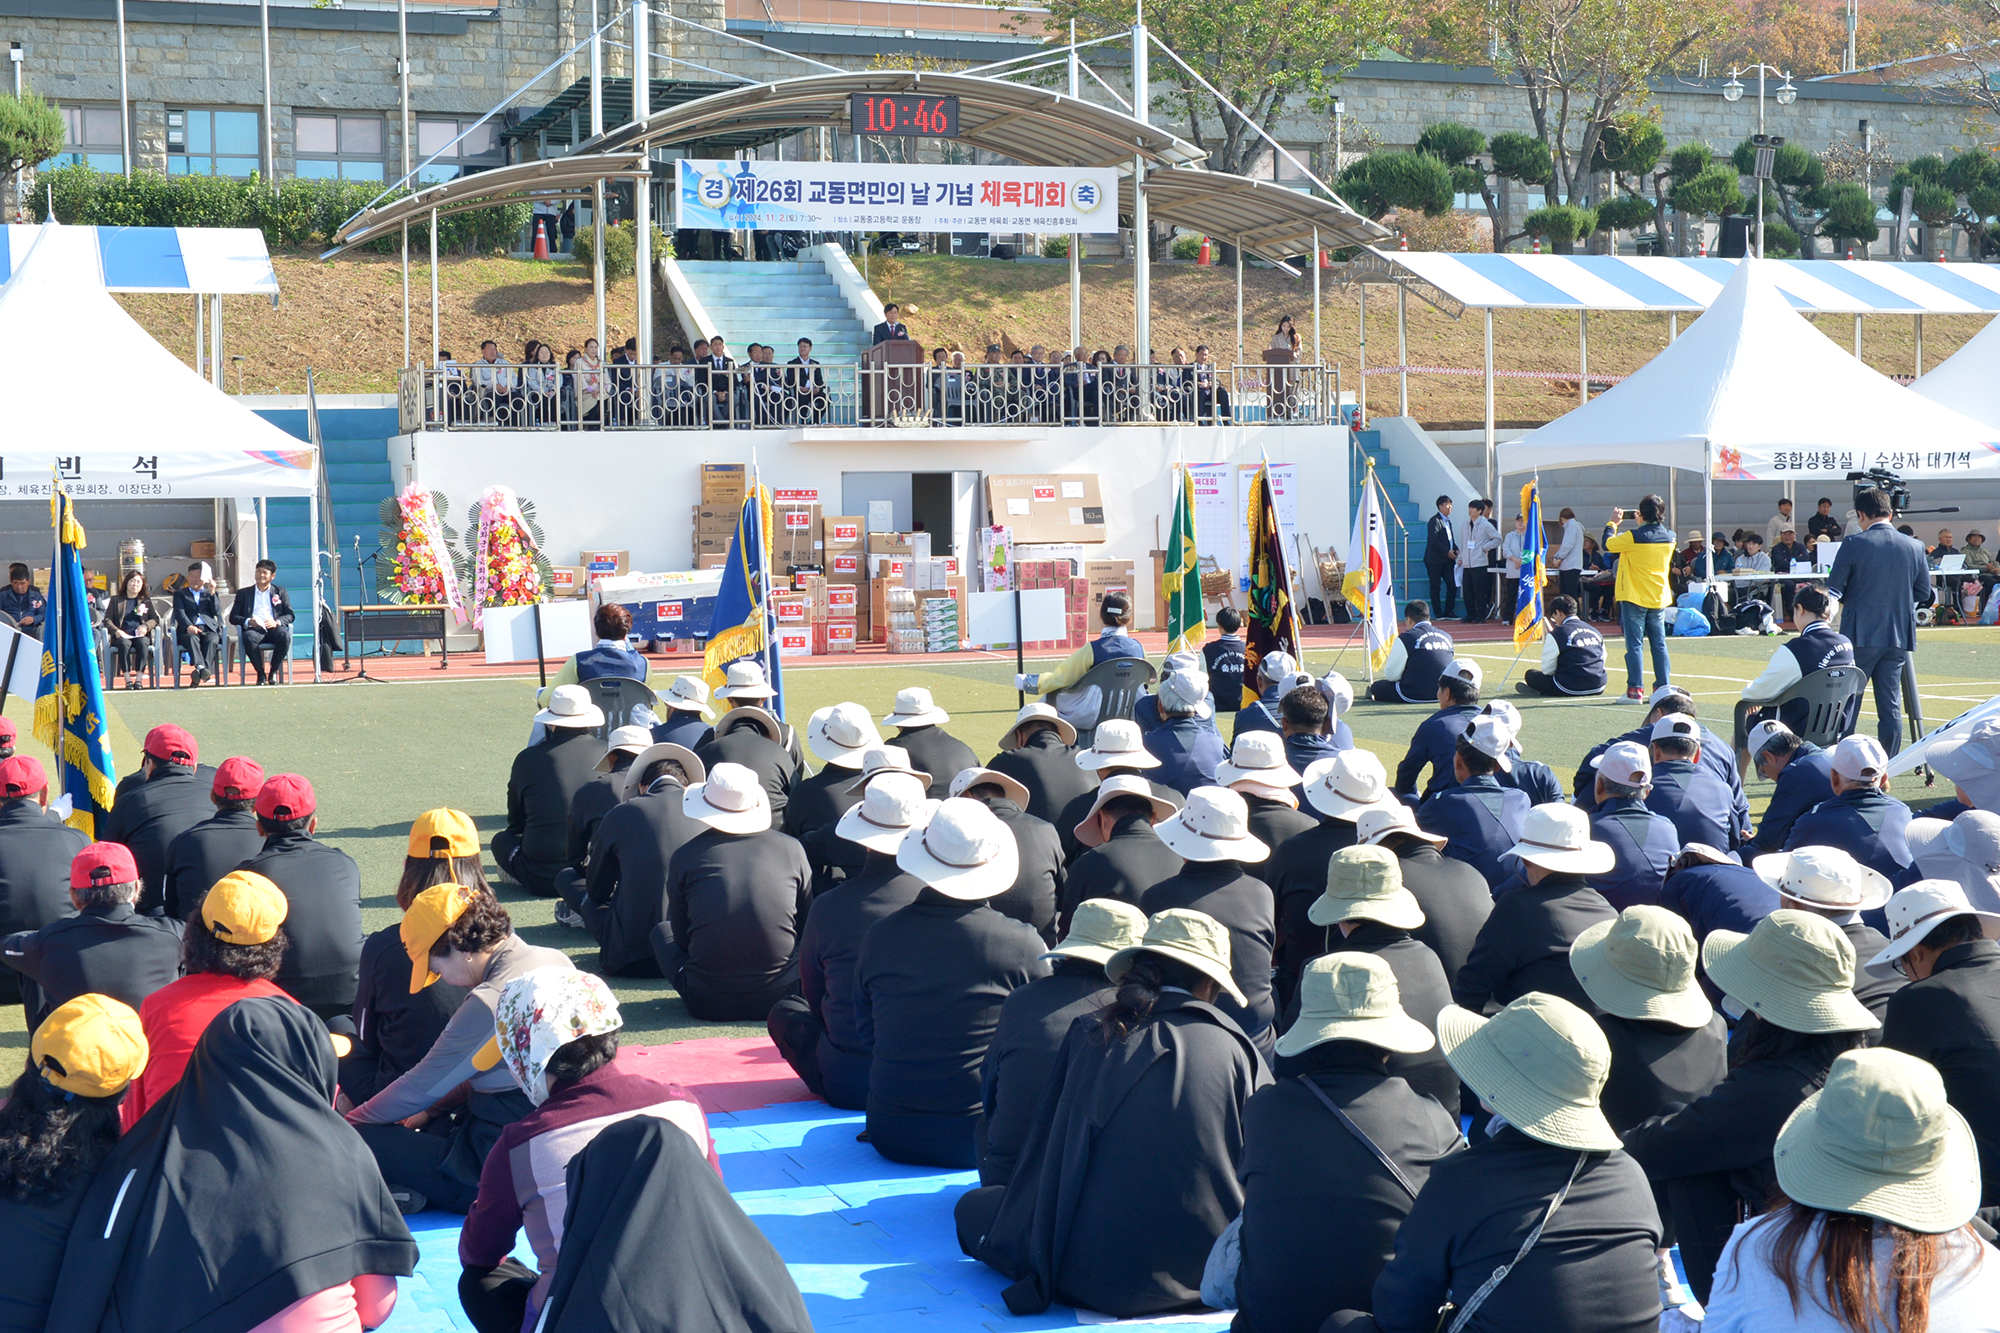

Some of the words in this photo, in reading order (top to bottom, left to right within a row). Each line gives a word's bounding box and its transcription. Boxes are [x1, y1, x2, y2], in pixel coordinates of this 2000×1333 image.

[864, 97, 947, 133] 10:46
[704, 179, 723, 199] 경
[736, 179, 802, 203] 제26회
[808, 181, 905, 205] 교동면민의
[910, 182, 931, 206] 날
[935, 182, 973, 207] 기념
[980, 180, 1066, 208] 체육대회
[1078, 185, 1095, 204] 축
[853, 215, 899, 224] 교동중고등학교
[901, 215, 921, 224] 운동장
[967, 217, 987, 225] 교동면
[57, 455, 82, 480] 빈
[132, 455, 158, 480] 석
[1773, 451, 1853, 470] 종합상황실
[1875, 451, 1920, 470] 수상자
[1927, 451, 1971, 470] 대기석
[18, 484, 112, 495] 체육진후원회장,
[118, 483, 162, 495] 이장단장
[993, 479, 1004, 487] LG
[1193, 478, 1217, 486] 육대회
[1818, 648, 1835, 670] lieve
